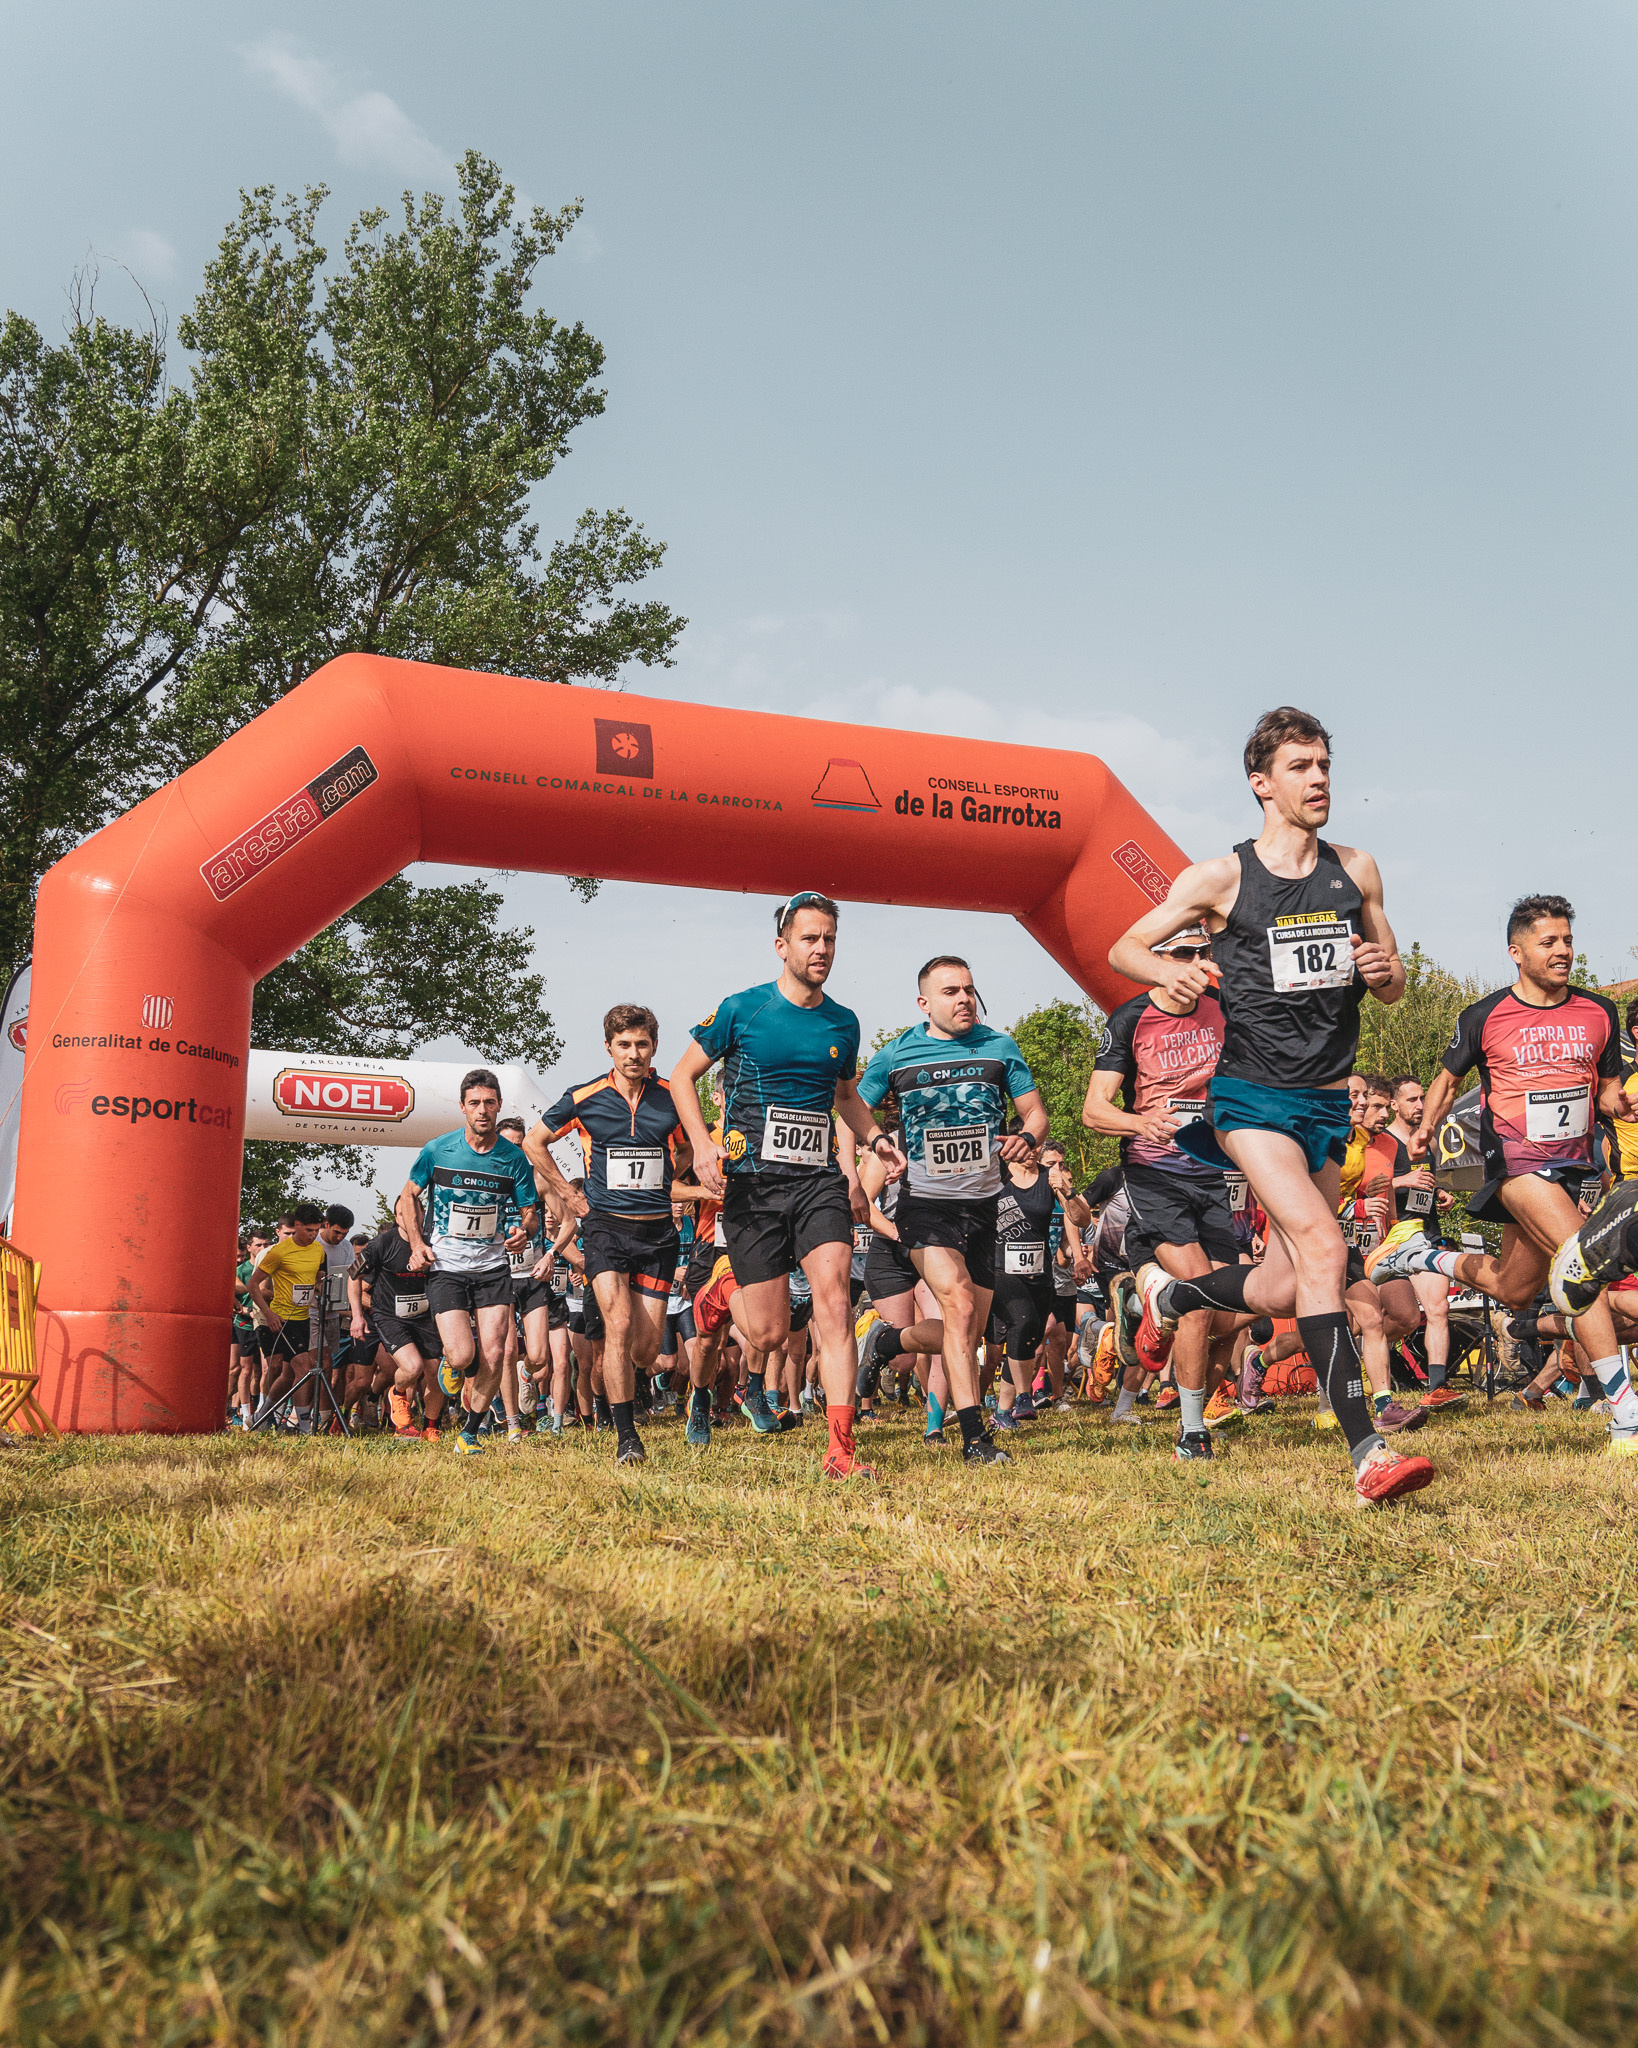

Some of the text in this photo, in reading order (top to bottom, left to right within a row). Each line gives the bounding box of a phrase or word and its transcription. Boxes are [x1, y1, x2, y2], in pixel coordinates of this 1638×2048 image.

[450, 767, 783, 811] CONSELL COMARCAL DE LA GARROTXA
[928, 777, 1059, 801] CONSELL ESPORTIU
[894, 789, 1061, 830] de la Garrotxa
[1275, 930, 1296, 940] CURSA
[1296, 929, 1304, 938] DE
[1305, 928, 1312, 937] LA
[1292, 942, 1337, 974] 182
[1160, 1027, 1216, 1049] TERRA DE
[1518, 1025, 1587, 1043] TERRA DE
[52, 1033, 239, 1069] Generalitat de Catalunya
[1156, 1041, 1223, 1070] VOLCANS
[1512, 1042, 1594, 1066] VOLCANS
[300, 1060, 385, 1071] XARCUTERIA
[932, 1067, 985, 1080] CNOLOT
[294, 1080, 394, 1111] NOEL
[772, 1111, 788, 1120] CURSA
[789, 1113, 796, 1121] DE
[1557, 1104, 1570, 1128] 2
[313, 1123, 339, 1131] TOTA
[928, 1130, 944, 1139] CURSA
[943, 1130, 950, 1138] DE
[950, 1129, 956, 1137] LA
[772, 1125, 823, 1153] 502A
[932, 1140, 983, 1165] 502B
[627, 1161, 645, 1180] 17
[463, 1177, 500, 1189] CNOLOT
[1415, 1192, 1429, 1206] 102
[466, 1216, 481, 1230] 71
[998, 1209, 1026, 1228] FOR
[1584, 1207, 1632, 1249] DYNAFIT
[1019, 1252, 1035, 1267] 94
[302, 1290, 310, 1300] 21
[406, 1302, 418, 1313] 78
